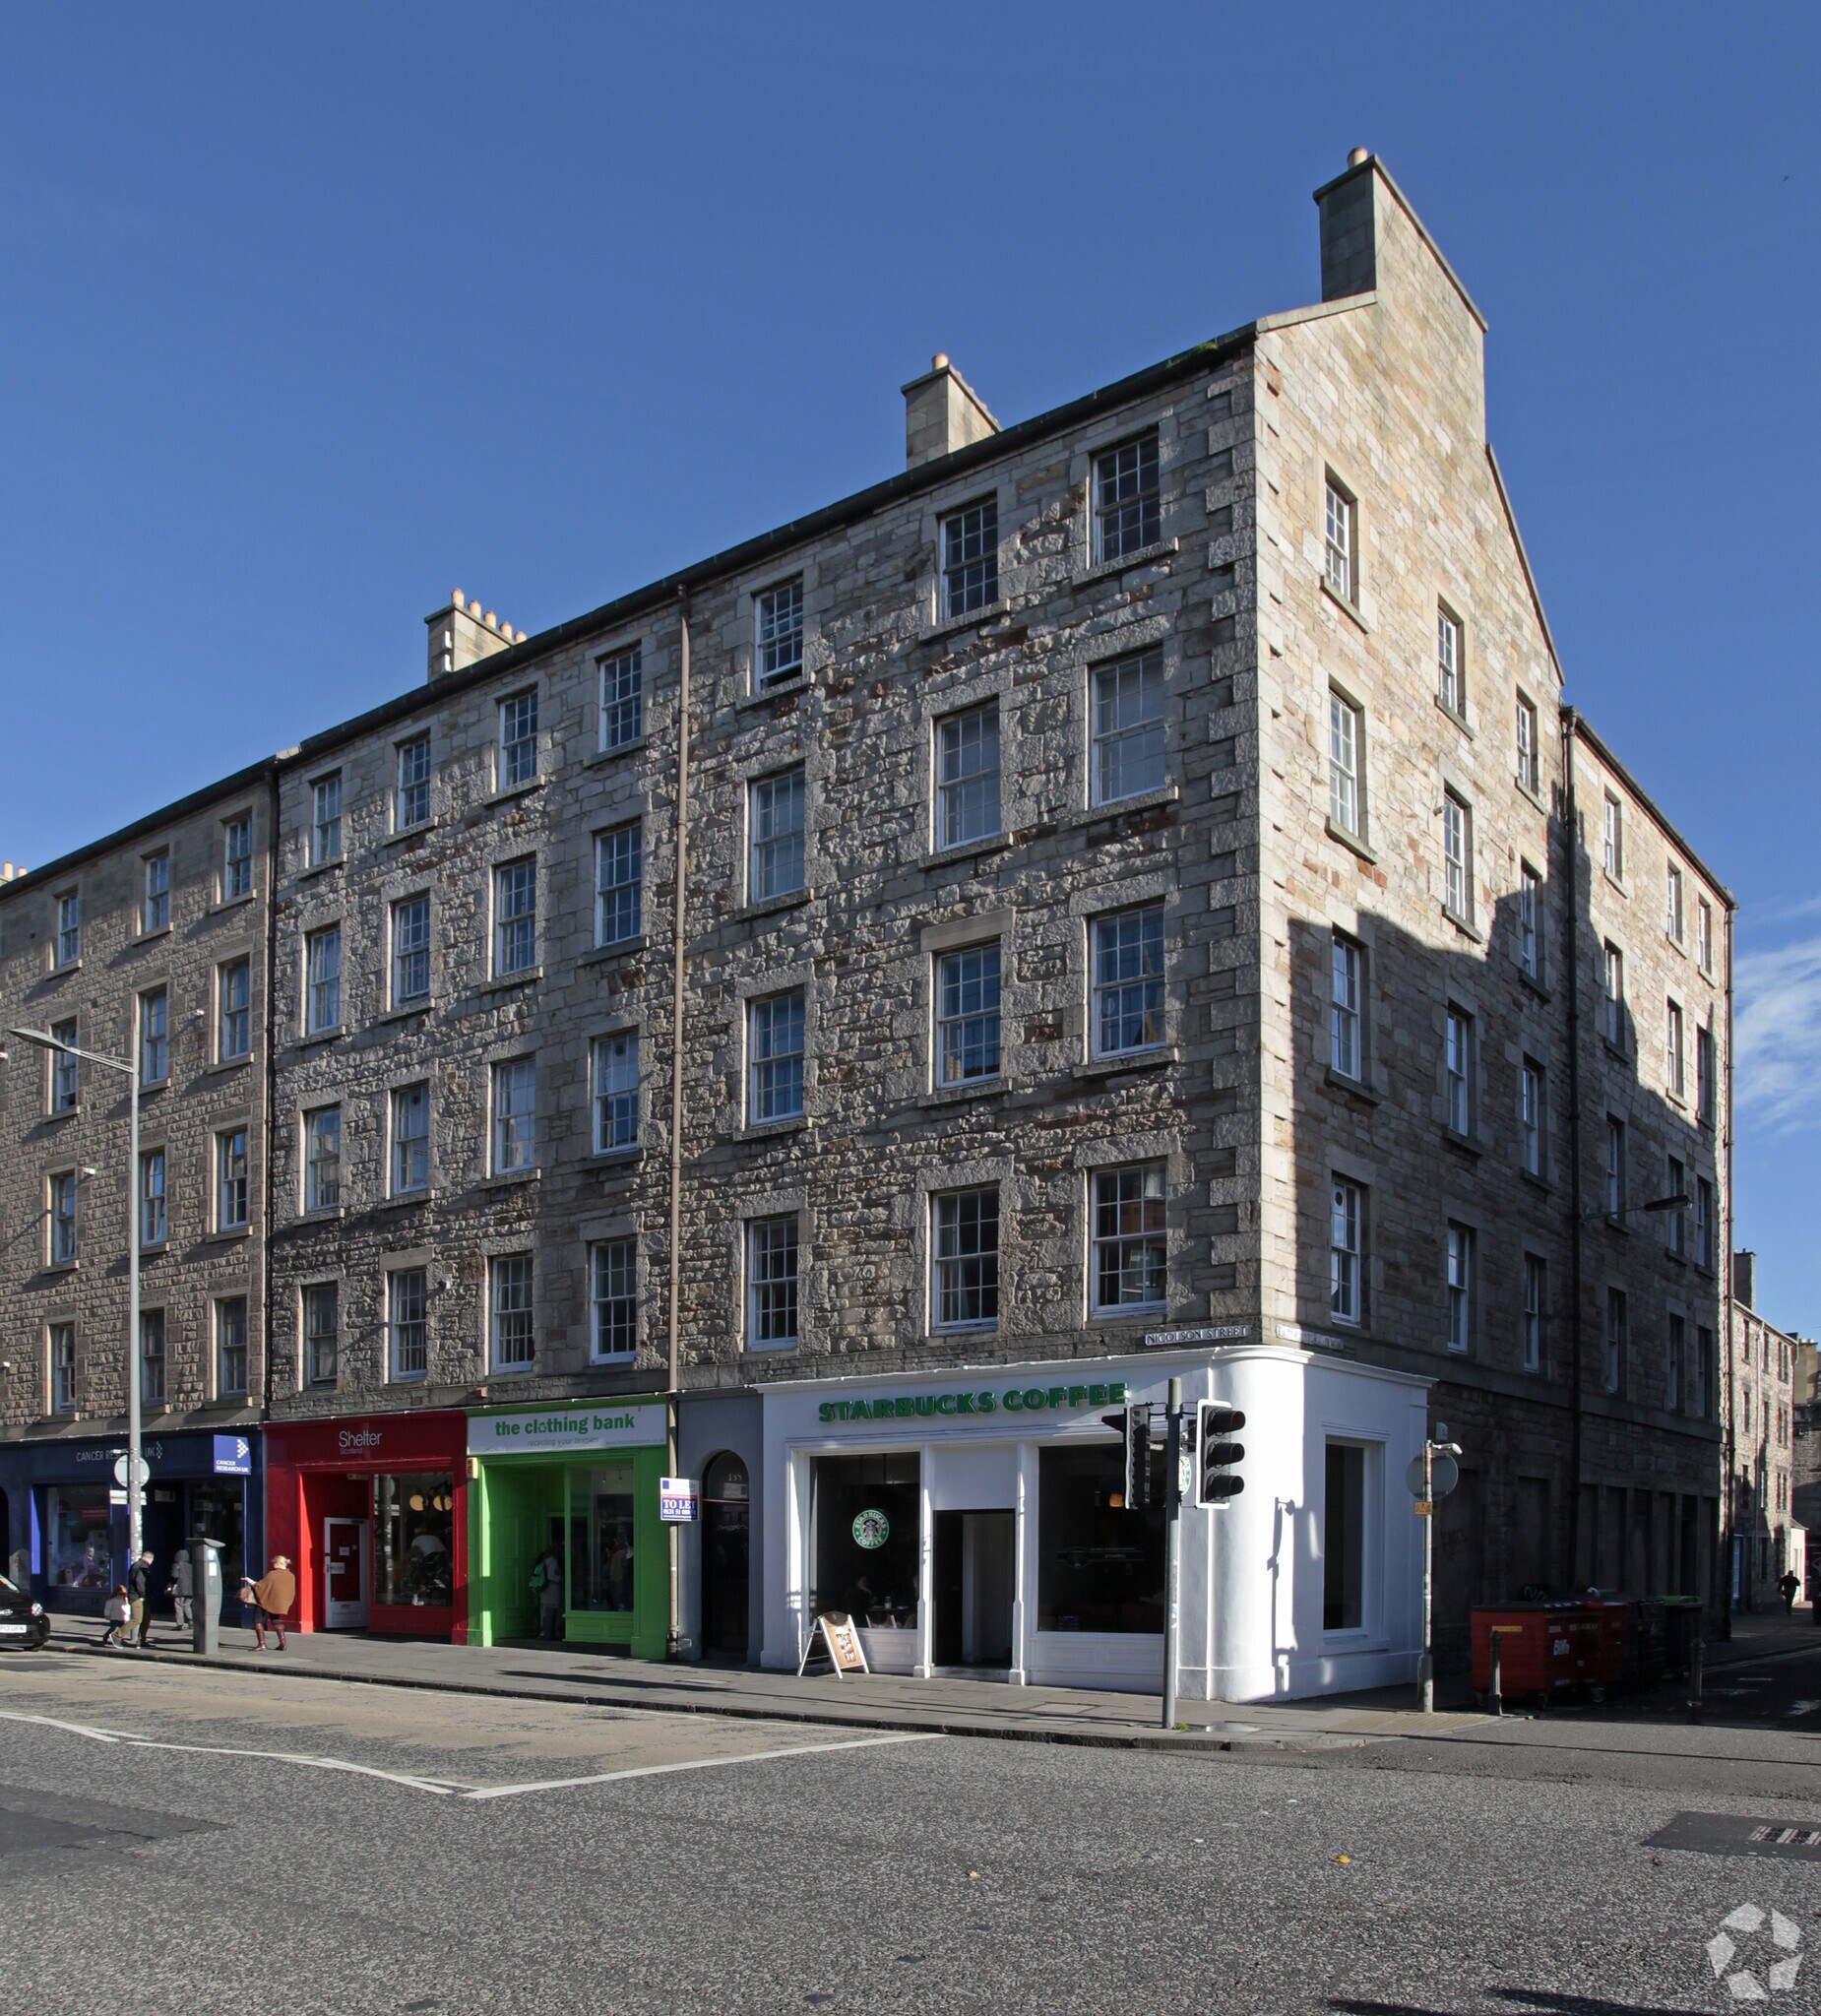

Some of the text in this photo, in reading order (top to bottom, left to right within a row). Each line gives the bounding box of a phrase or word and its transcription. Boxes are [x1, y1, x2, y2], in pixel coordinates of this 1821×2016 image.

[1147, 1326, 1247, 1345] NICOLSON STREET
[818, 1382, 1128, 1422] STARBUCKS COFFEE
[495, 1413, 635, 1436] the clothing bank
[339, 1430, 382, 1448] Shelter
[527, 1438, 556, 1447] recycling
[557, 1437, 573, 1446] your
[76, 1450, 104, 1462] CANCER
[145, 1447, 155, 1457] UK
[662, 1499, 697, 1509] TO LET
[854, 1512, 887, 1529] STARBUCKS
[858, 1537, 883, 1546] COFFEE
